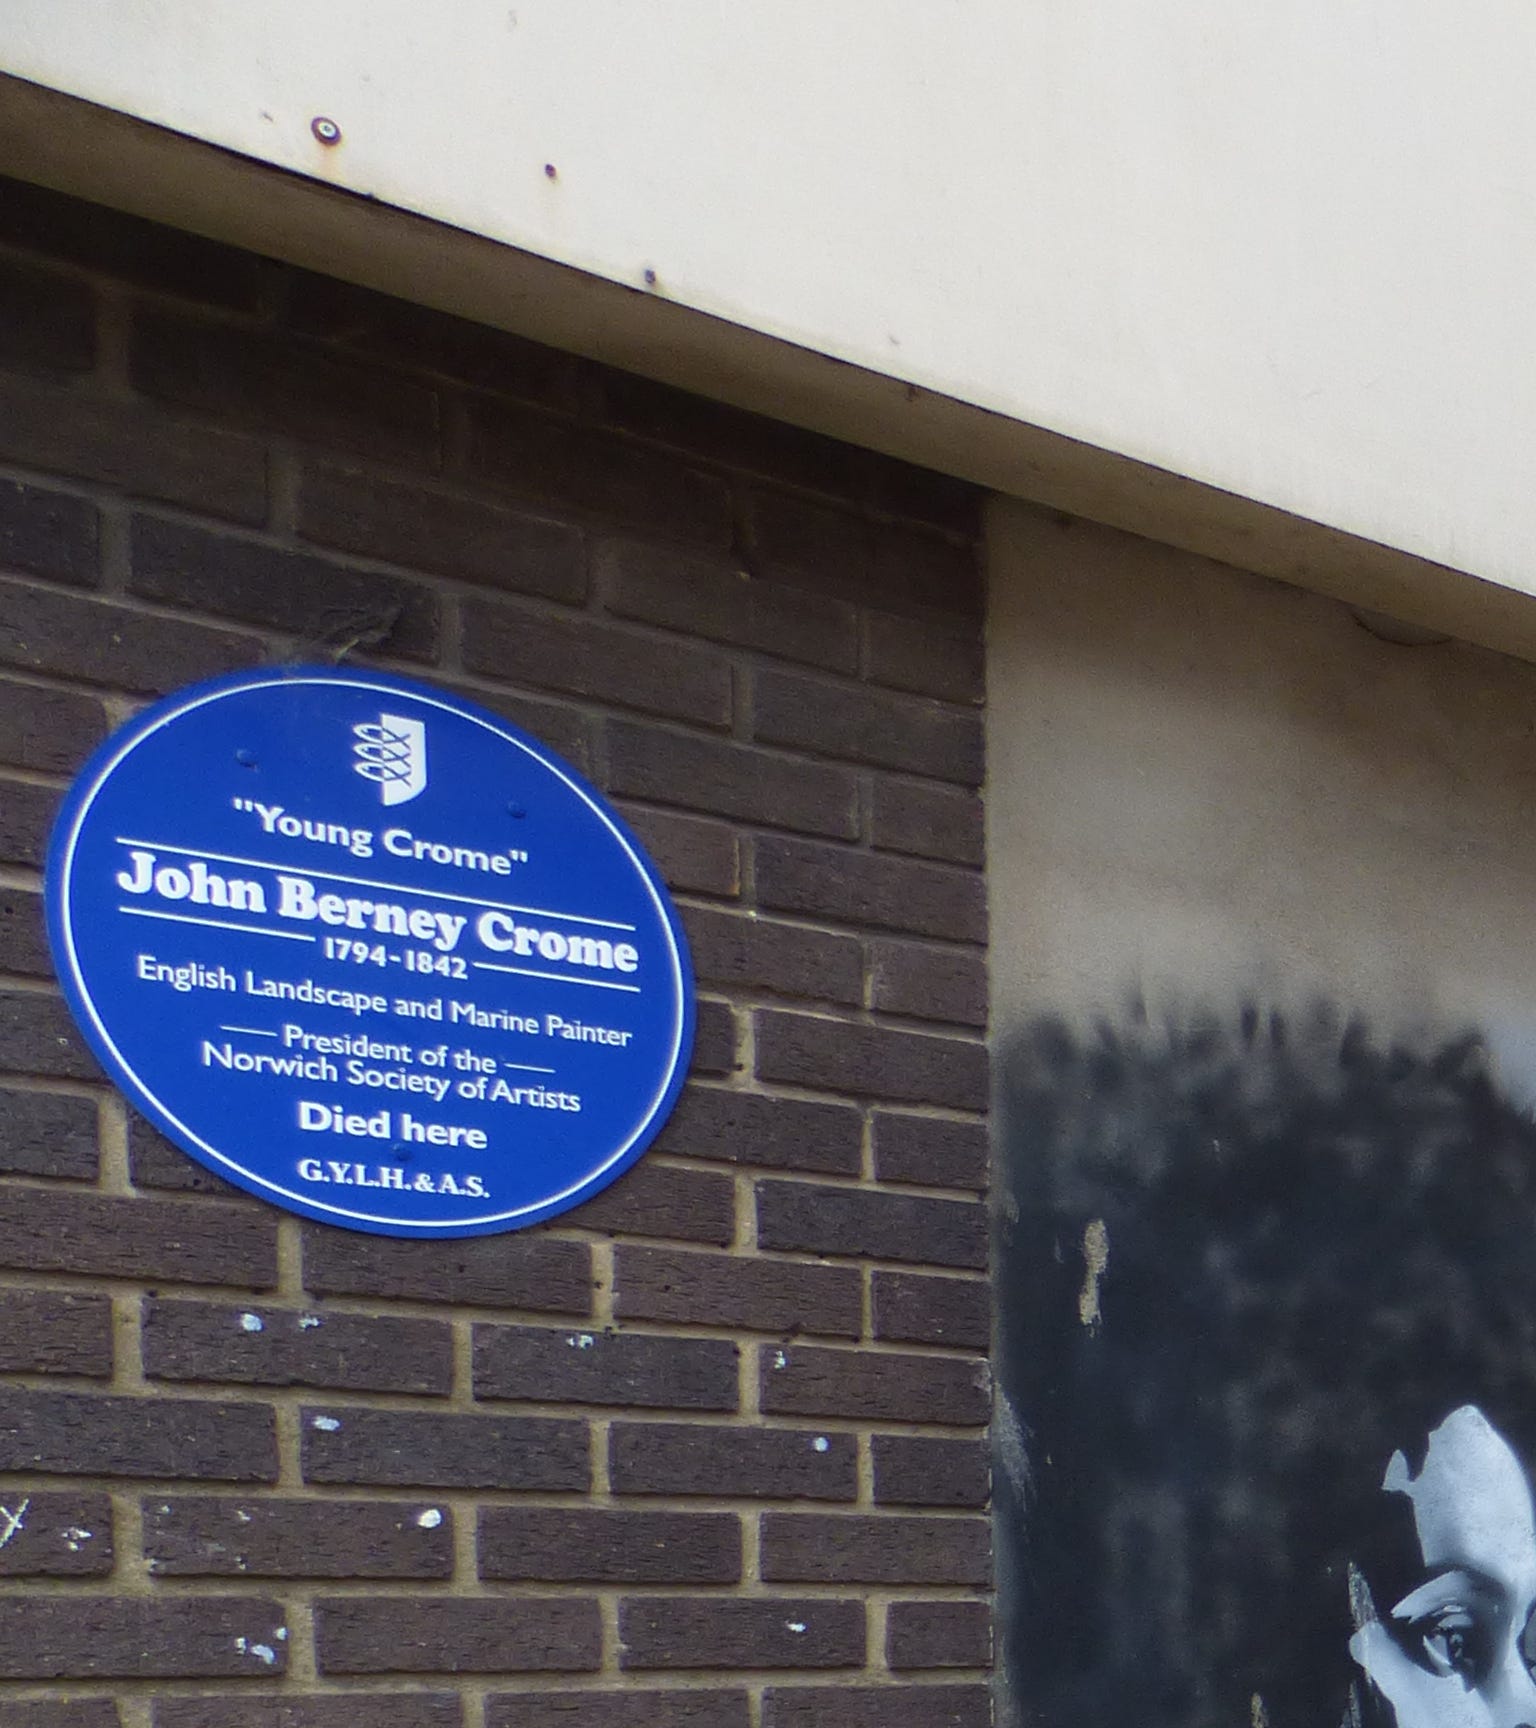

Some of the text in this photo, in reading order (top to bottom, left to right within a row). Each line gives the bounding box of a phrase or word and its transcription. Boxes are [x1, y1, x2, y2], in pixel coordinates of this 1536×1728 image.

[234, 797, 528, 876] "Young Crome"
[117, 852, 639, 973] John Berney Crome
[324, 937, 469, 980] 1794-1842
[138, 956, 632, 1048] English Landscape and Marine Painter
[203, 1041, 581, 1113] Norwich Society of Artists
[285, 1026, 497, 1073] President of the
[299, 1103, 488, 1150] Died here
